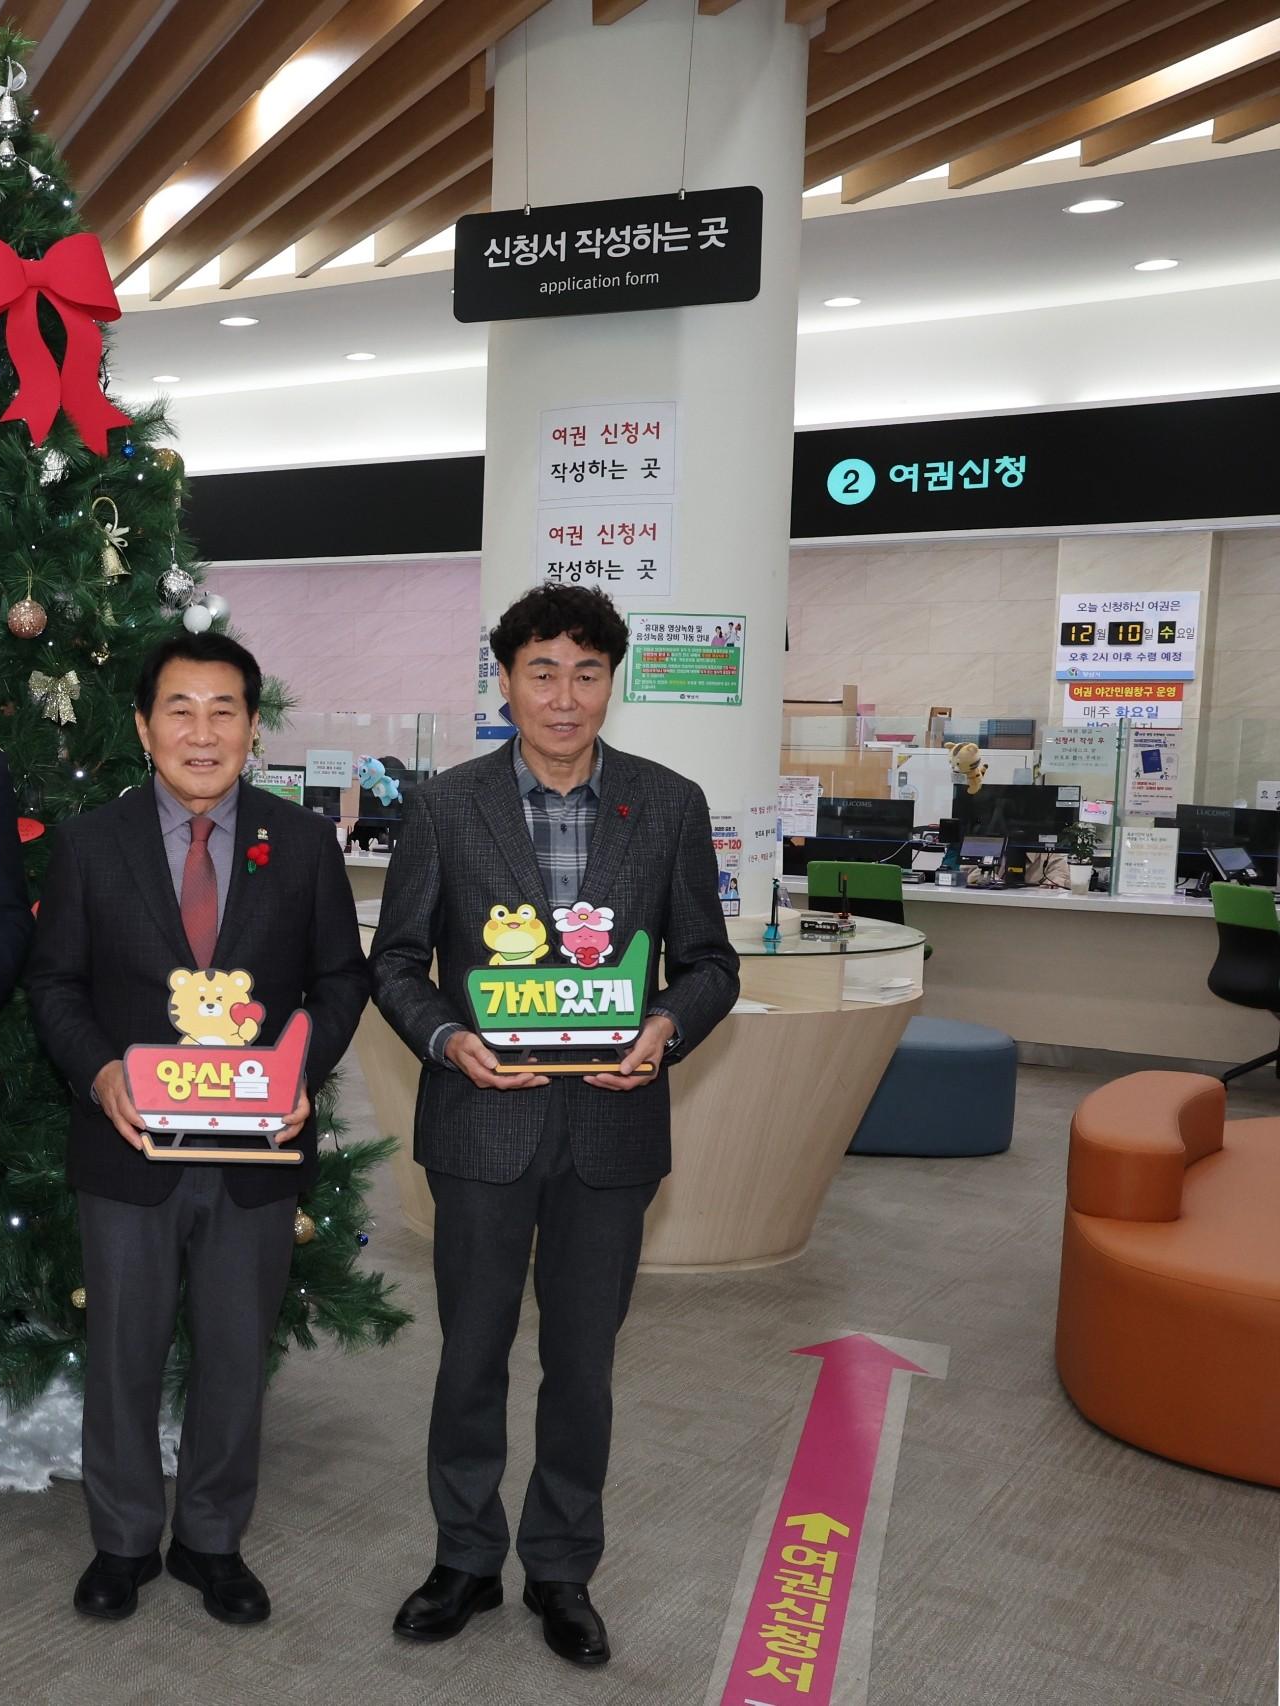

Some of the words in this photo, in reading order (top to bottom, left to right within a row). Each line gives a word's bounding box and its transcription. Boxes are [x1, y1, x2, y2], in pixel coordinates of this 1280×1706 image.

[483, 231, 567, 268] 신청서
[574, 221, 691, 259] 작성하는
[697, 216, 729, 250] 곳
[539, 274, 620, 295] application
[625, 271, 659, 285] form
[552, 425, 587, 447] 여권
[600, 421, 661, 445] 신청서
[550, 459, 628, 483] 작성하는
[640, 457, 661, 479] 곳
[842, 469, 860, 494] 2
[889, 455, 1026, 493] 여권신청
[548, 525, 583, 546] 여권
[596, 522, 657, 546] 신청서
[547, 559, 624, 582] 작성하는
[637, 559, 657, 580] 곳
[1076, 602, 1098, 613] 오늘
[1101, 601, 1145, 613] 신청하신
[1148, 600, 1181, 612] 여권은
[645, 624, 665, 633] 휴대용
[1068, 652, 1089, 662] 오후
[1092, 653, 1109, 662] 2시
[1112, 652, 1133, 662] 이후
[1136, 652, 1157, 662] 수령
[1161, 651, 1182, 662] 예정
[1073, 687, 1093, 698] 여권
[1095, 686, 1154, 698] 야간민원창구
[1156, 686, 1177, 697] 운영
[1083, 705, 1111, 719] 매주
[1115, 705, 1159, 719] 화요일
[478, 978, 635, 1017] 가치있게
[156, 1059, 270, 1100] 양산을
[745, 1544, 839, 1693] 여권신청서
